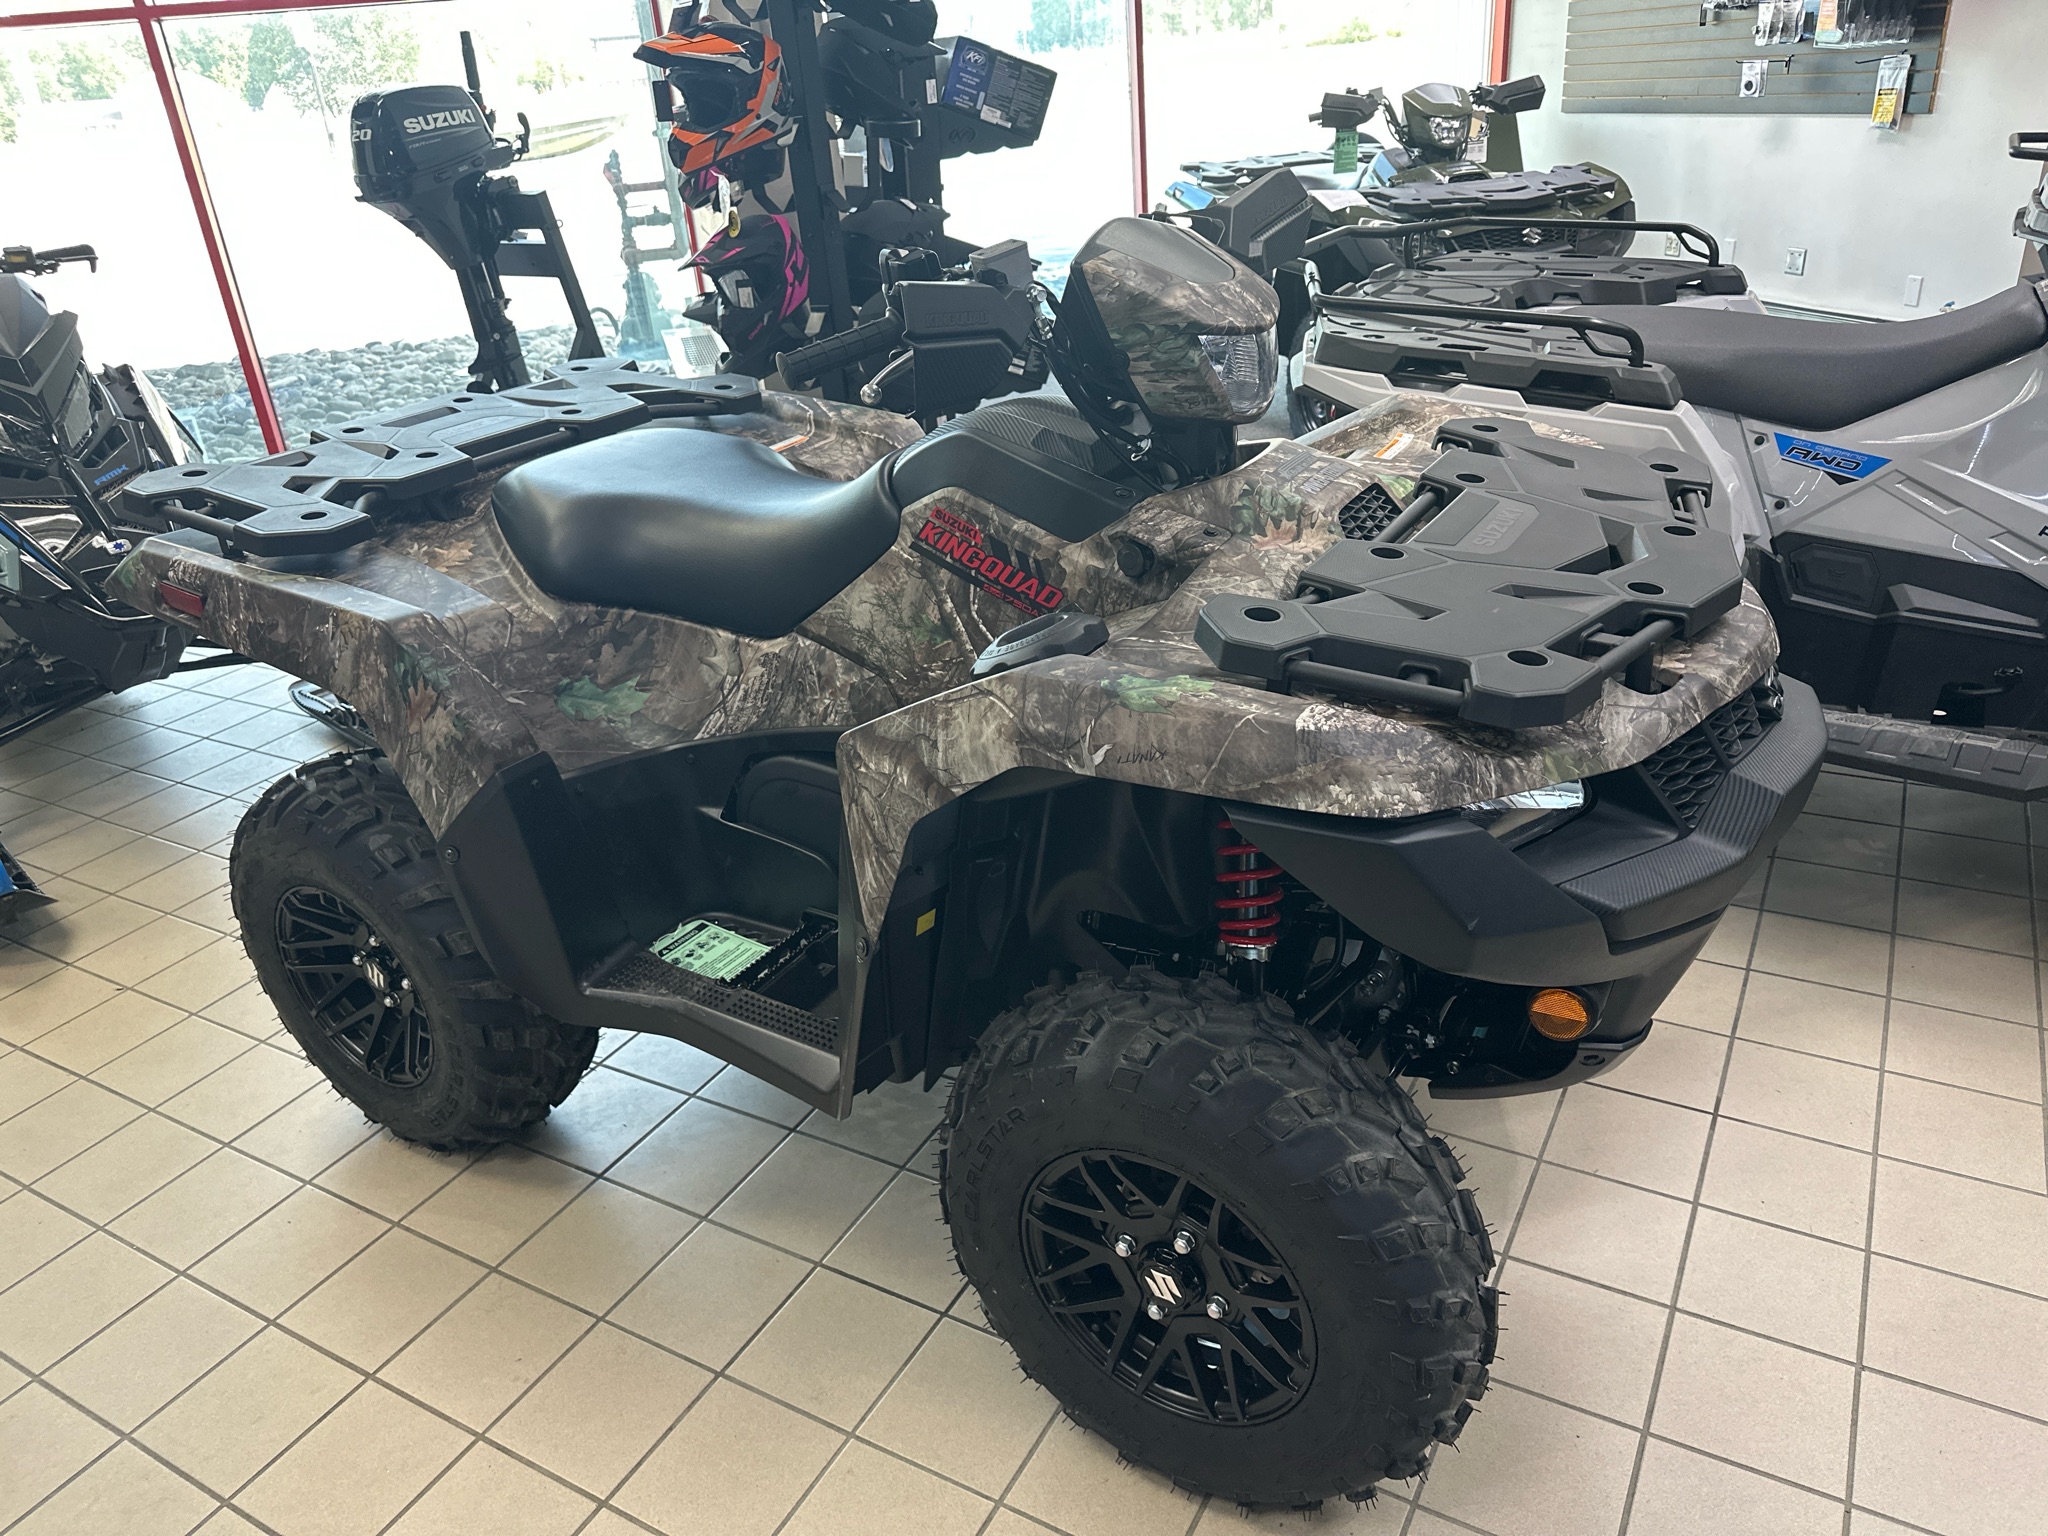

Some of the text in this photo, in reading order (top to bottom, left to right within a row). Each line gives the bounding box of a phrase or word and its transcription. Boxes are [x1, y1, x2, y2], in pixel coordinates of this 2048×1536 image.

[352, 128, 372, 142] 20
[403, 108, 476, 134] SUZUKI
[1784, 444, 1863, 472] AWD
[1793, 439, 1868, 461] ON DEMAND
[94, 463, 130, 486] RMK
[933, 508, 979, 541] SUZUKI
[1471, 507, 1525, 547] SUZUKI
[918, 520, 1065, 609] KINGQUAD
[964, 1105, 1027, 1222] CARLSTAR
